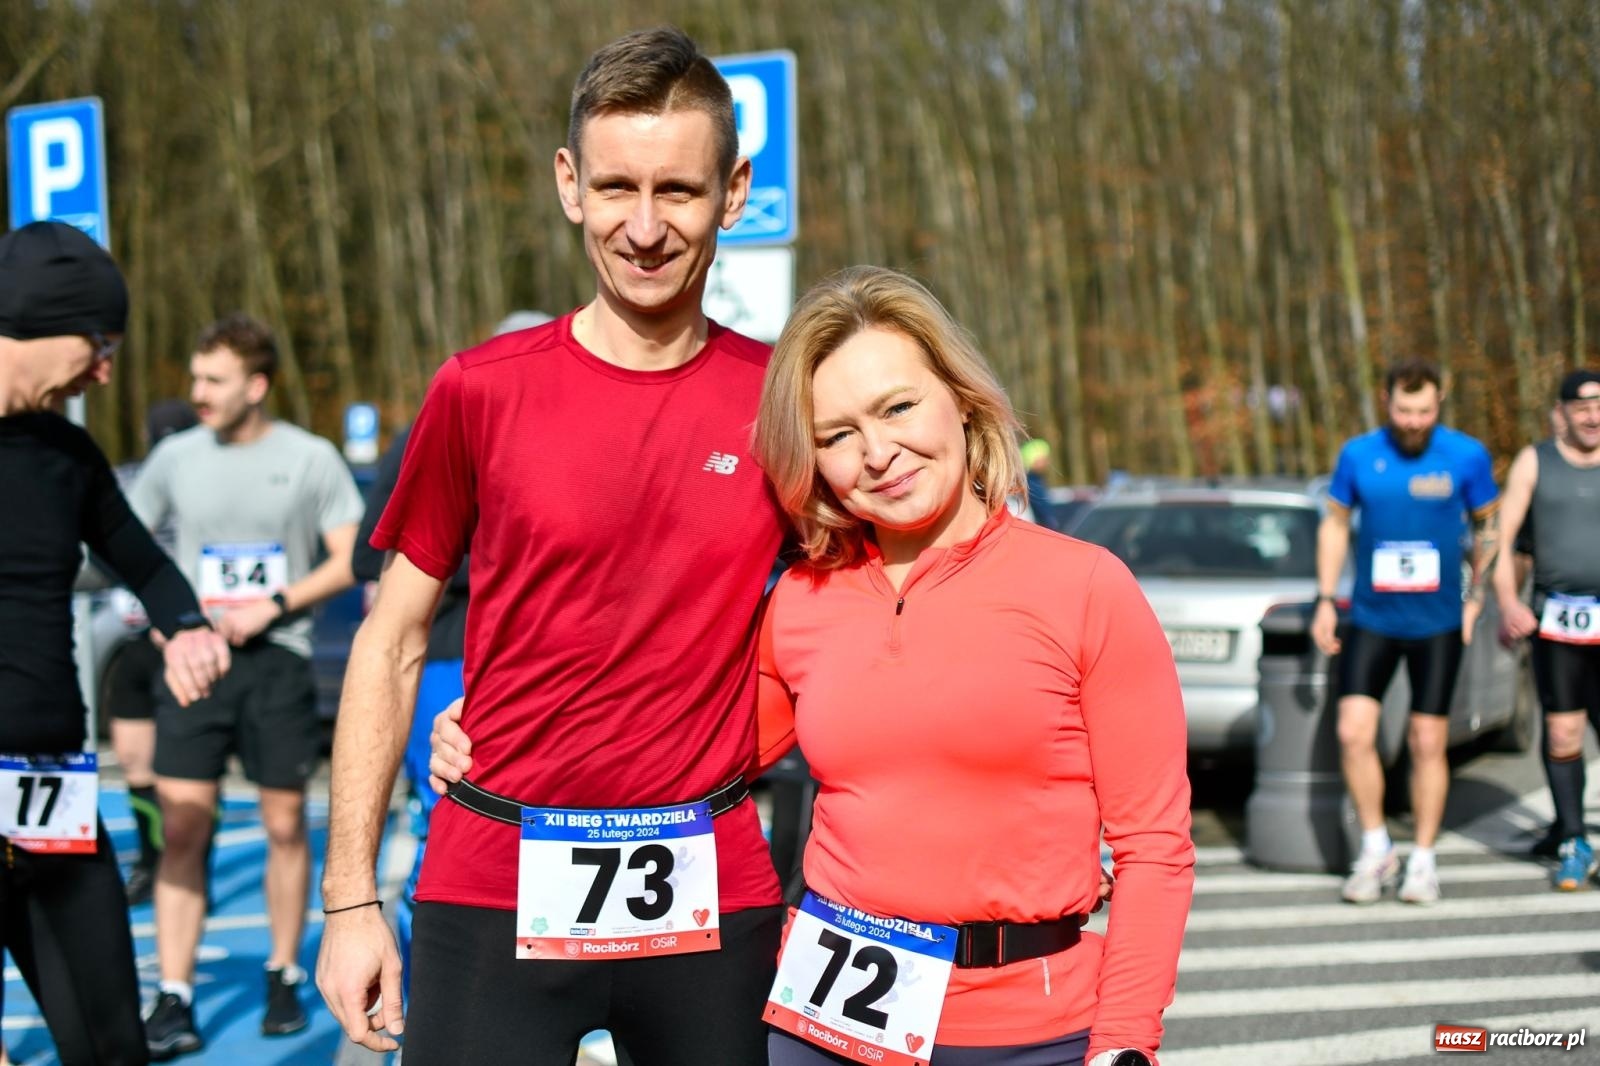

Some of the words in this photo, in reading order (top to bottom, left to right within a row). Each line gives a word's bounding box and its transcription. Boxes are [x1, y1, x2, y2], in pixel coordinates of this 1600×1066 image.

[29, 116, 84, 221] P
[221, 557, 267, 589] 54
[1400, 552, 1416, 577] 5
[1557, 604, 1591, 632] 40
[17, 776, 63, 826] 17
[545, 812, 565, 827] XII
[567, 813, 603, 828] BIEG
[604, 809, 697, 828] TWARDZIELA
[587, 829, 600, 839] 25
[602, 828, 635, 841] lutego
[636, 827, 660, 838] 2024
[571, 844, 675, 924] 73
[835, 913, 842, 924] 25
[842, 916, 867, 934] lutego
[868, 926, 892, 940] 2024
[583, 941, 640, 954] Racibórz
[809, 928, 898, 1030] 72
[808, 1023, 849, 1051] Racibórz
